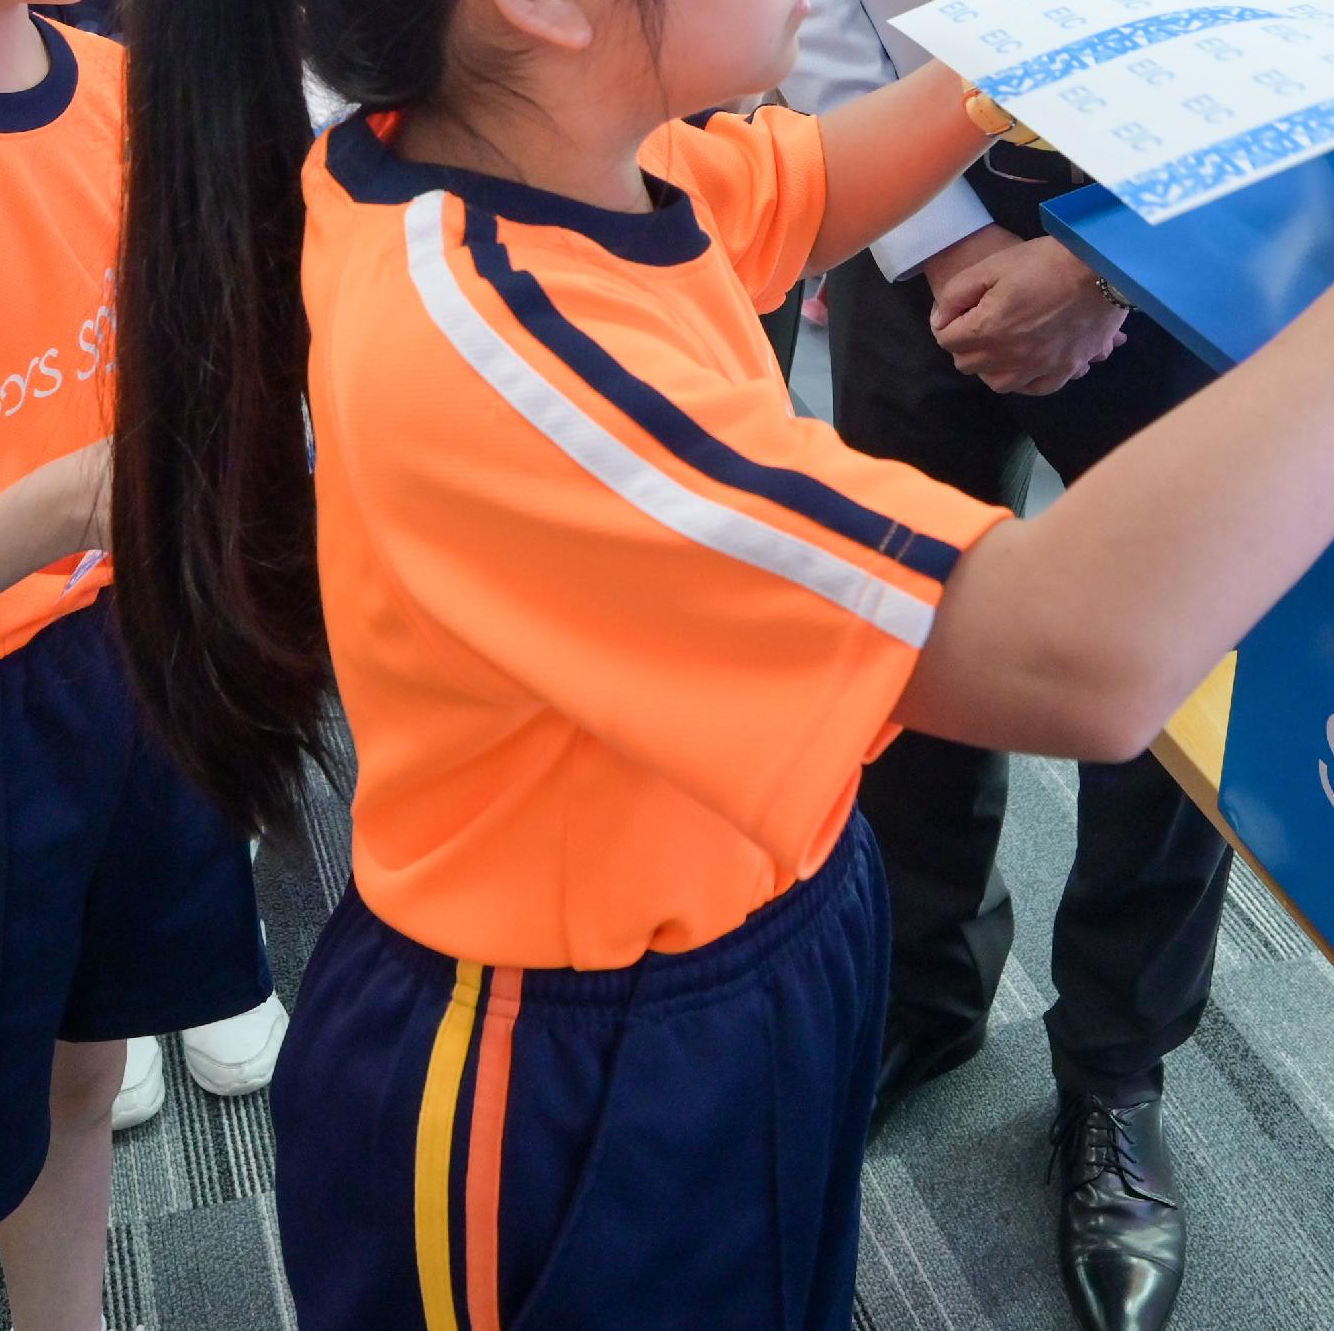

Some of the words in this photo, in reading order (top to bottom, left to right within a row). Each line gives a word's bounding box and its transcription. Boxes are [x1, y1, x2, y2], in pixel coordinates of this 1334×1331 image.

[938, 0, 980, 24] EIC
[1043, 5, 1088, 31] EIC
[978, 27, 1024, 55] EIC
[1194, 36, 1244, 62] EIC
[1126, 57, 1176, 86] EIC
[1250, 68, 1306, 96] EIC
[1058, 83, 1108, 114] EIC
[1182, 93, 1235, 125] EIC
[1111, 120, 1163, 152] EIC
